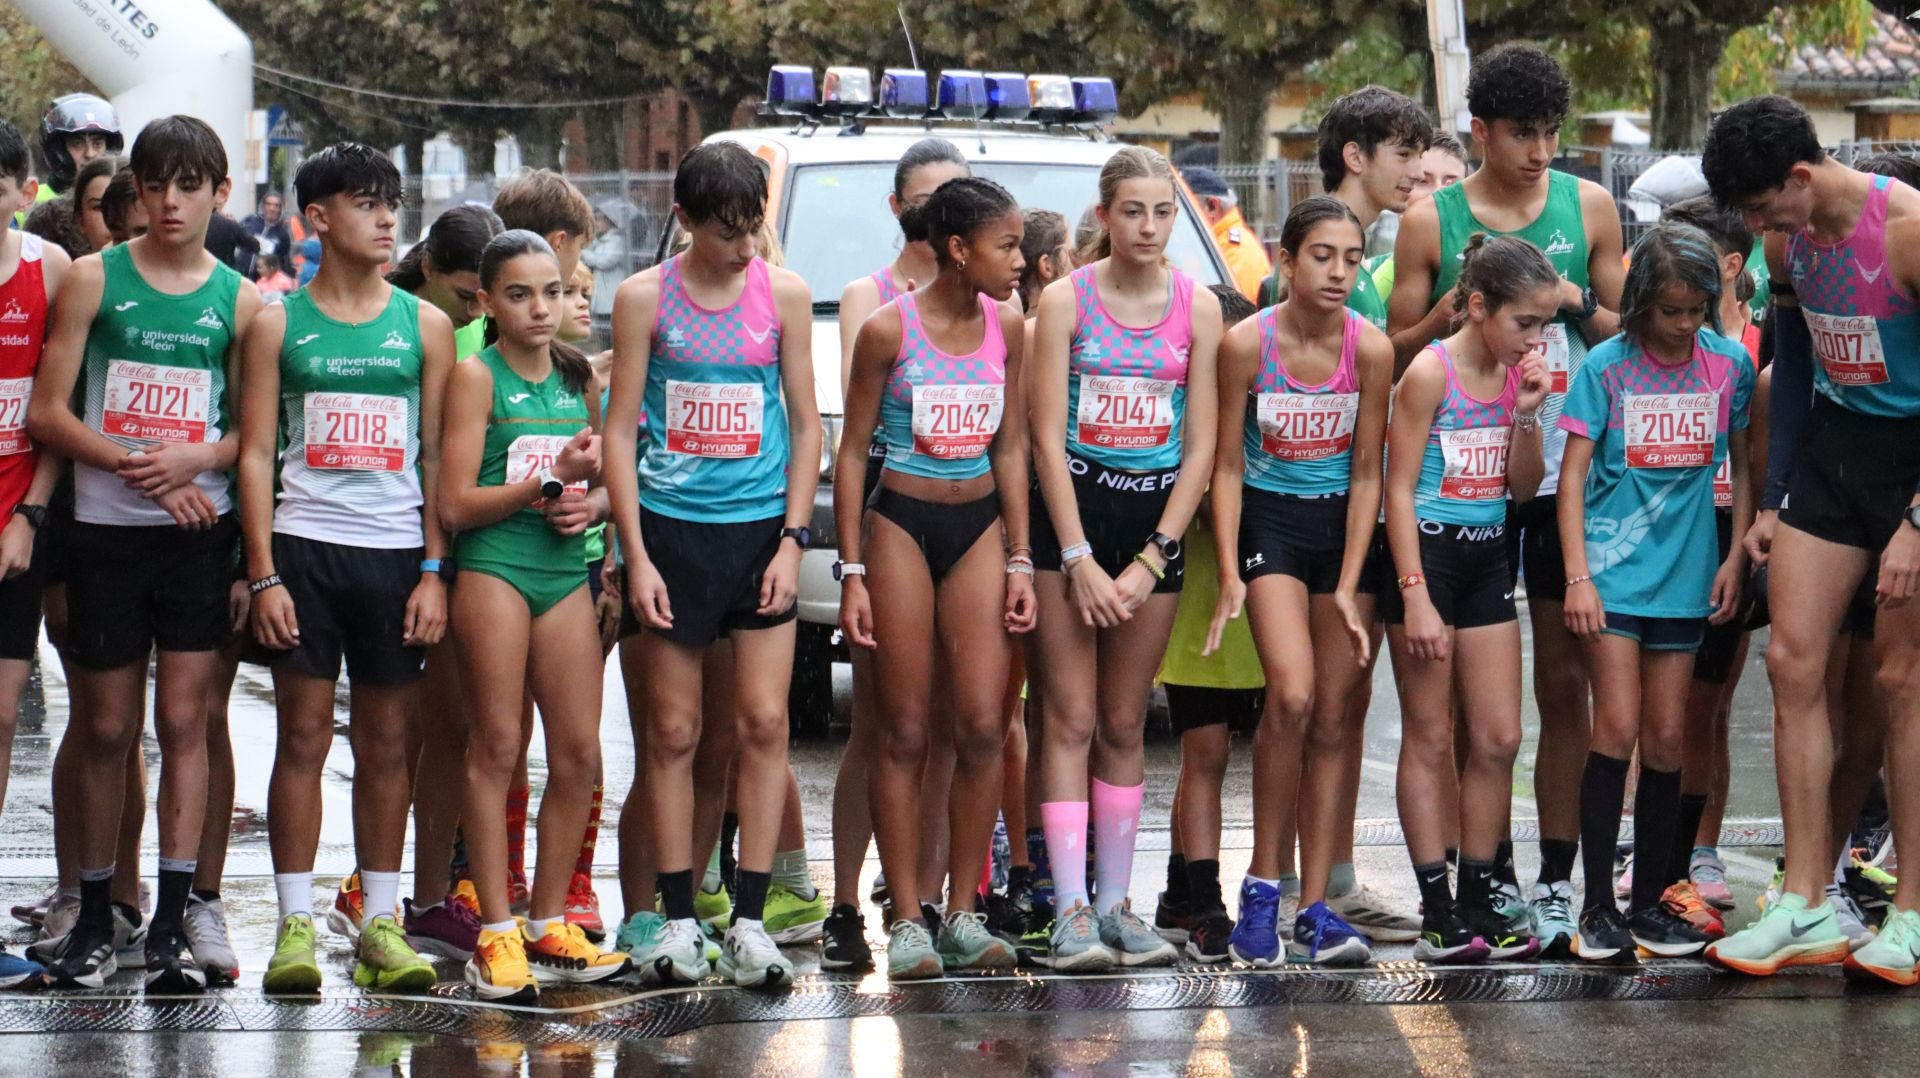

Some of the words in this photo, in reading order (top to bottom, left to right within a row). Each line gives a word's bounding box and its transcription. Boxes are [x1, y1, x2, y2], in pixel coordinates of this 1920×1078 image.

[95, 17, 111, 33] de
[142, 330, 210, 346] universidad
[150, 339, 175, 351] león
[1814, 329, 1862, 362] 2007
[327, 356, 401, 368] universidad
[337, 366, 364, 376] león
[127, 382, 188, 418] 2021
[682, 400, 747, 432] 2005
[930, 403, 989, 434] 2042
[141, 426, 190, 439] HYUNDAI
[326, 412, 386, 445] 2018
[1275, 411, 1341, 439] 2037
[1642, 411, 1705, 443] 2045
[1114, 435, 1157, 444] HYUNDAI
[701, 443, 747, 453] HYUNDAI
[1294, 446, 1338, 457] HYUNDAI
[342, 455, 388, 465] HYUNDAI
[1664, 453, 1705, 462] HYUNDAI
[1096, 470, 1157, 492] NIKE
[1455, 524, 1505, 541] NIKE
